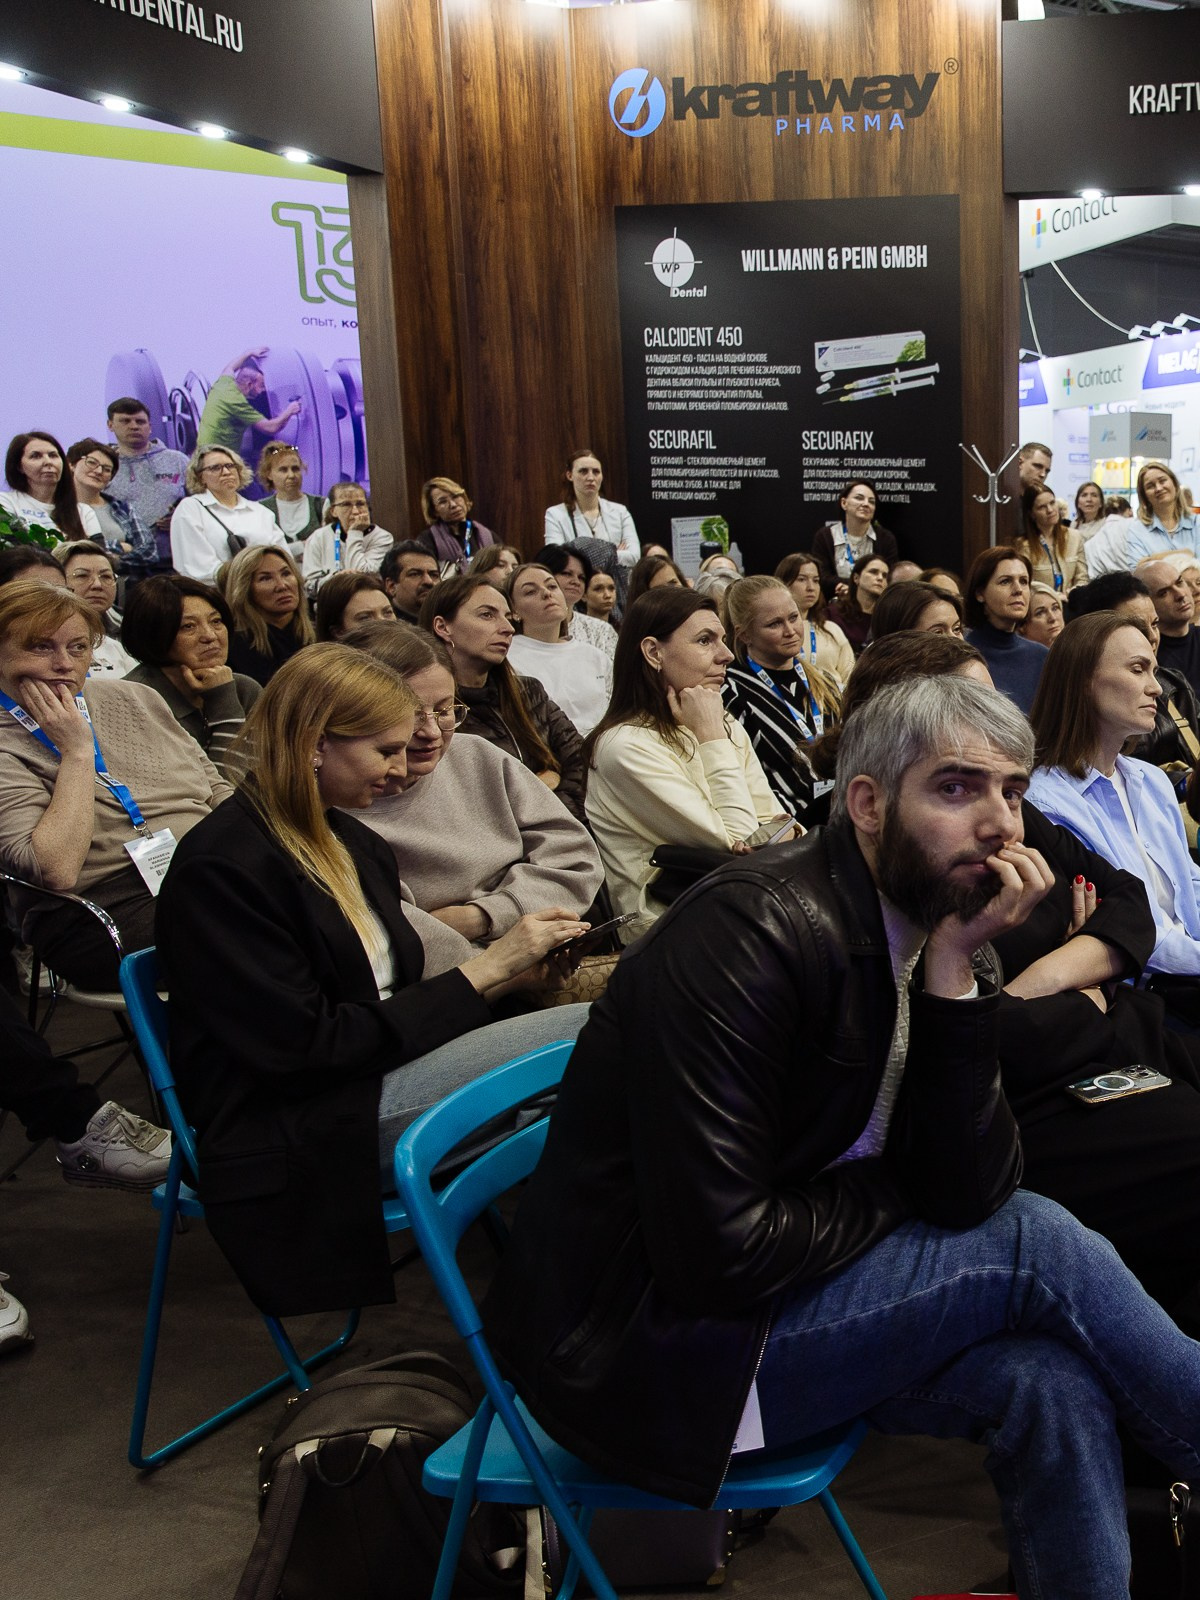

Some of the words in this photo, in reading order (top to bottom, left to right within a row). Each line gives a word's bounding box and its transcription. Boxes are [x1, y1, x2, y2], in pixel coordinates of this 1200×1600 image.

[94, 0, 244, 53] DENTAL.RU
[776, 113, 905, 137] PHARMA
[741, 247, 824, 272] WILLMANN
[828, 248, 838, 271] &
[842, 246, 878, 270] PEIN
[880, 244, 928, 269] GMBH
[671, 285, 707, 298] Dental
[644, 327, 713, 347] CALCIDENT
[716, 326, 743, 347] 450
[1077, 366, 1123, 389] Contact
[649, 430, 717, 449] SECURAFIL
[802, 431, 874, 450] SECURAFIX
